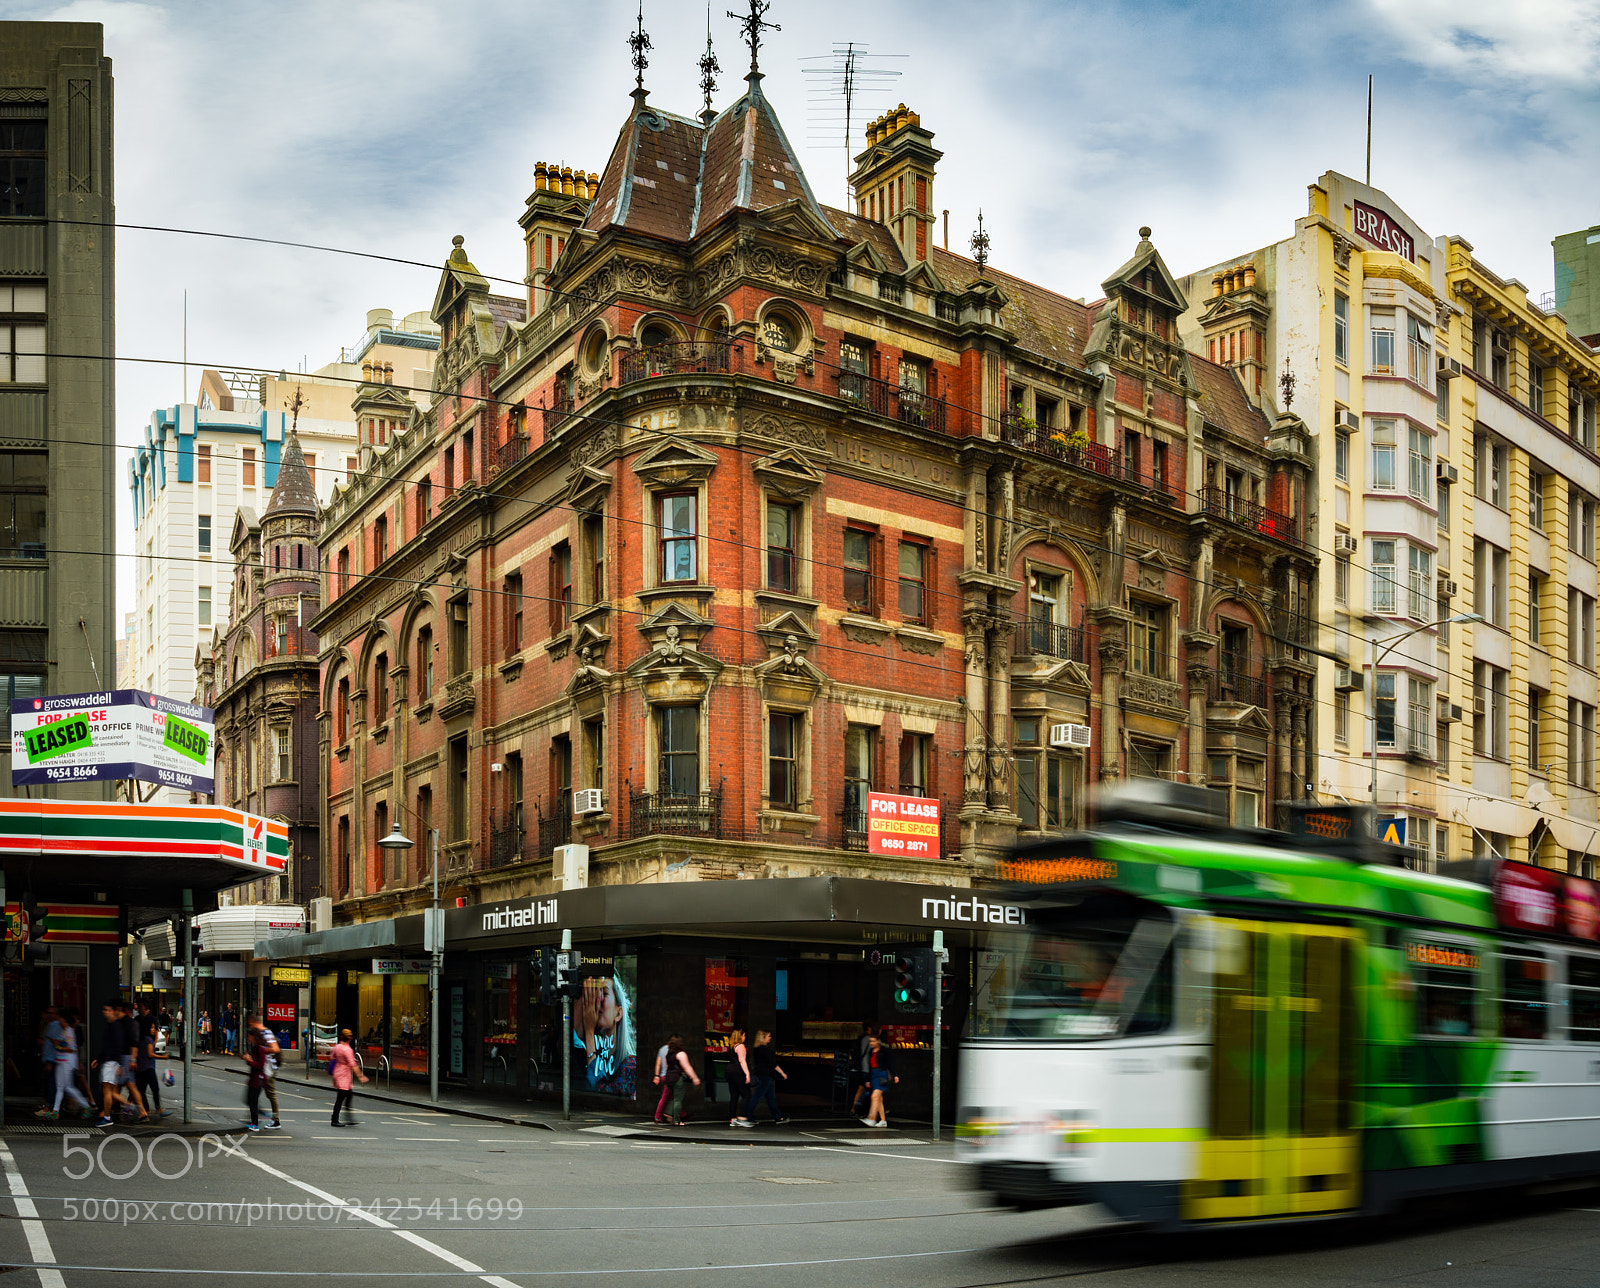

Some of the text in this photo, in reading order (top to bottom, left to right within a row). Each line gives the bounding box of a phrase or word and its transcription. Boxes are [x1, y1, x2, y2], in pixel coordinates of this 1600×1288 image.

[1356, 207, 1410, 261] BRASH
[833, 438, 953, 485] THE CITY OF
[1016, 488, 1097, 529] ELBOURNE
[441, 522, 478, 560] BUILDING
[1127, 523, 1183, 556] UILDING
[44, 692, 112, 711] grosswaddell
[157, 700, 203, 719] grosswaddell
[37, 714, 62, 726] FOR
[102, 722, 132, 732] OFFICE
[135, 723, 154, 734] PRIME
[27, 721, 88, 756] LEASED
[166, 720, 206, 756] LEASED
[46, 765, 98, 778] 9654 8666
[158, 769, 175, 781] 9654
[176, 773, 193, 785] 8666
[871, 799, 938, 818] FOR LEASE
[872, 820, 937, 835] OFFICE SPACE
[881, 838, 928, 852] 9650 2871
[482, 898, 558, 931] michael hill
[580, 956, 613, 965] chael hill
[708, 982, 730, 992] SALE
[268, 1006, 295, 1018] SALE
